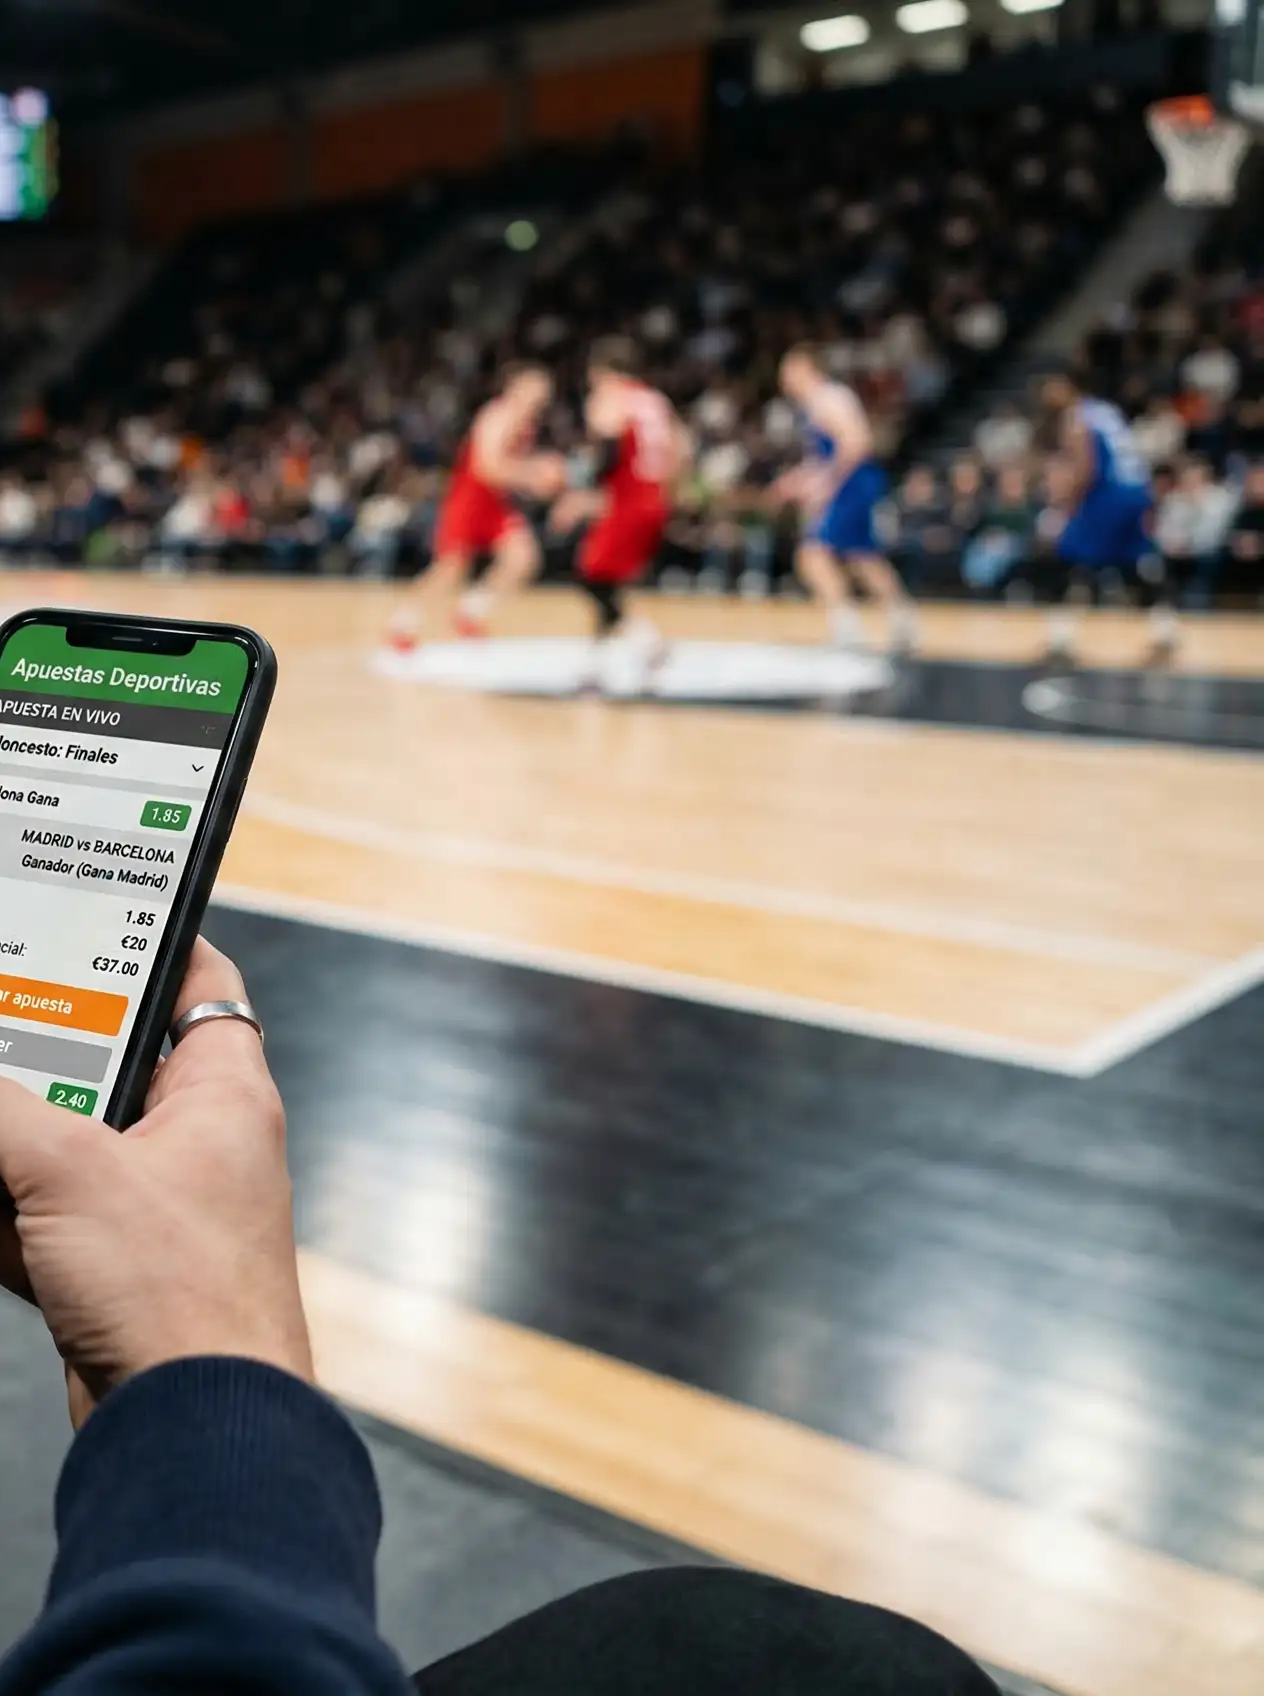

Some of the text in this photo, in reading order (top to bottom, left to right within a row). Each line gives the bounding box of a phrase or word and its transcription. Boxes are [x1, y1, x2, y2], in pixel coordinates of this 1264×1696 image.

[11, 657, 222, 697] Apuestas Deportivas
[61, 706, 82, 721] EN
[85, 709, 121, 726] VIVO
[65, 744, 119, 764] Finales
[27, 791, 60, 807] Gana
[151, 807, 181, 824] 1.85
[22, 830, 74, 848] MADRID
[77, 839, 91, 851] vs
[93, 840, 175, 864] BARCELONA
[21, 854, 75, 876] Ganador
[76, 862, 114, 881] (Gana
[116, 870, 169, 892] Madrid)
[125, 910, 155, 926] 1.85
[121, 935, 147, 951] €20
[92, 956, 139, 976] €37.00
[12, 992, 73, 1015] apuesta
[55, 1090, 87, 1108] 2.40
